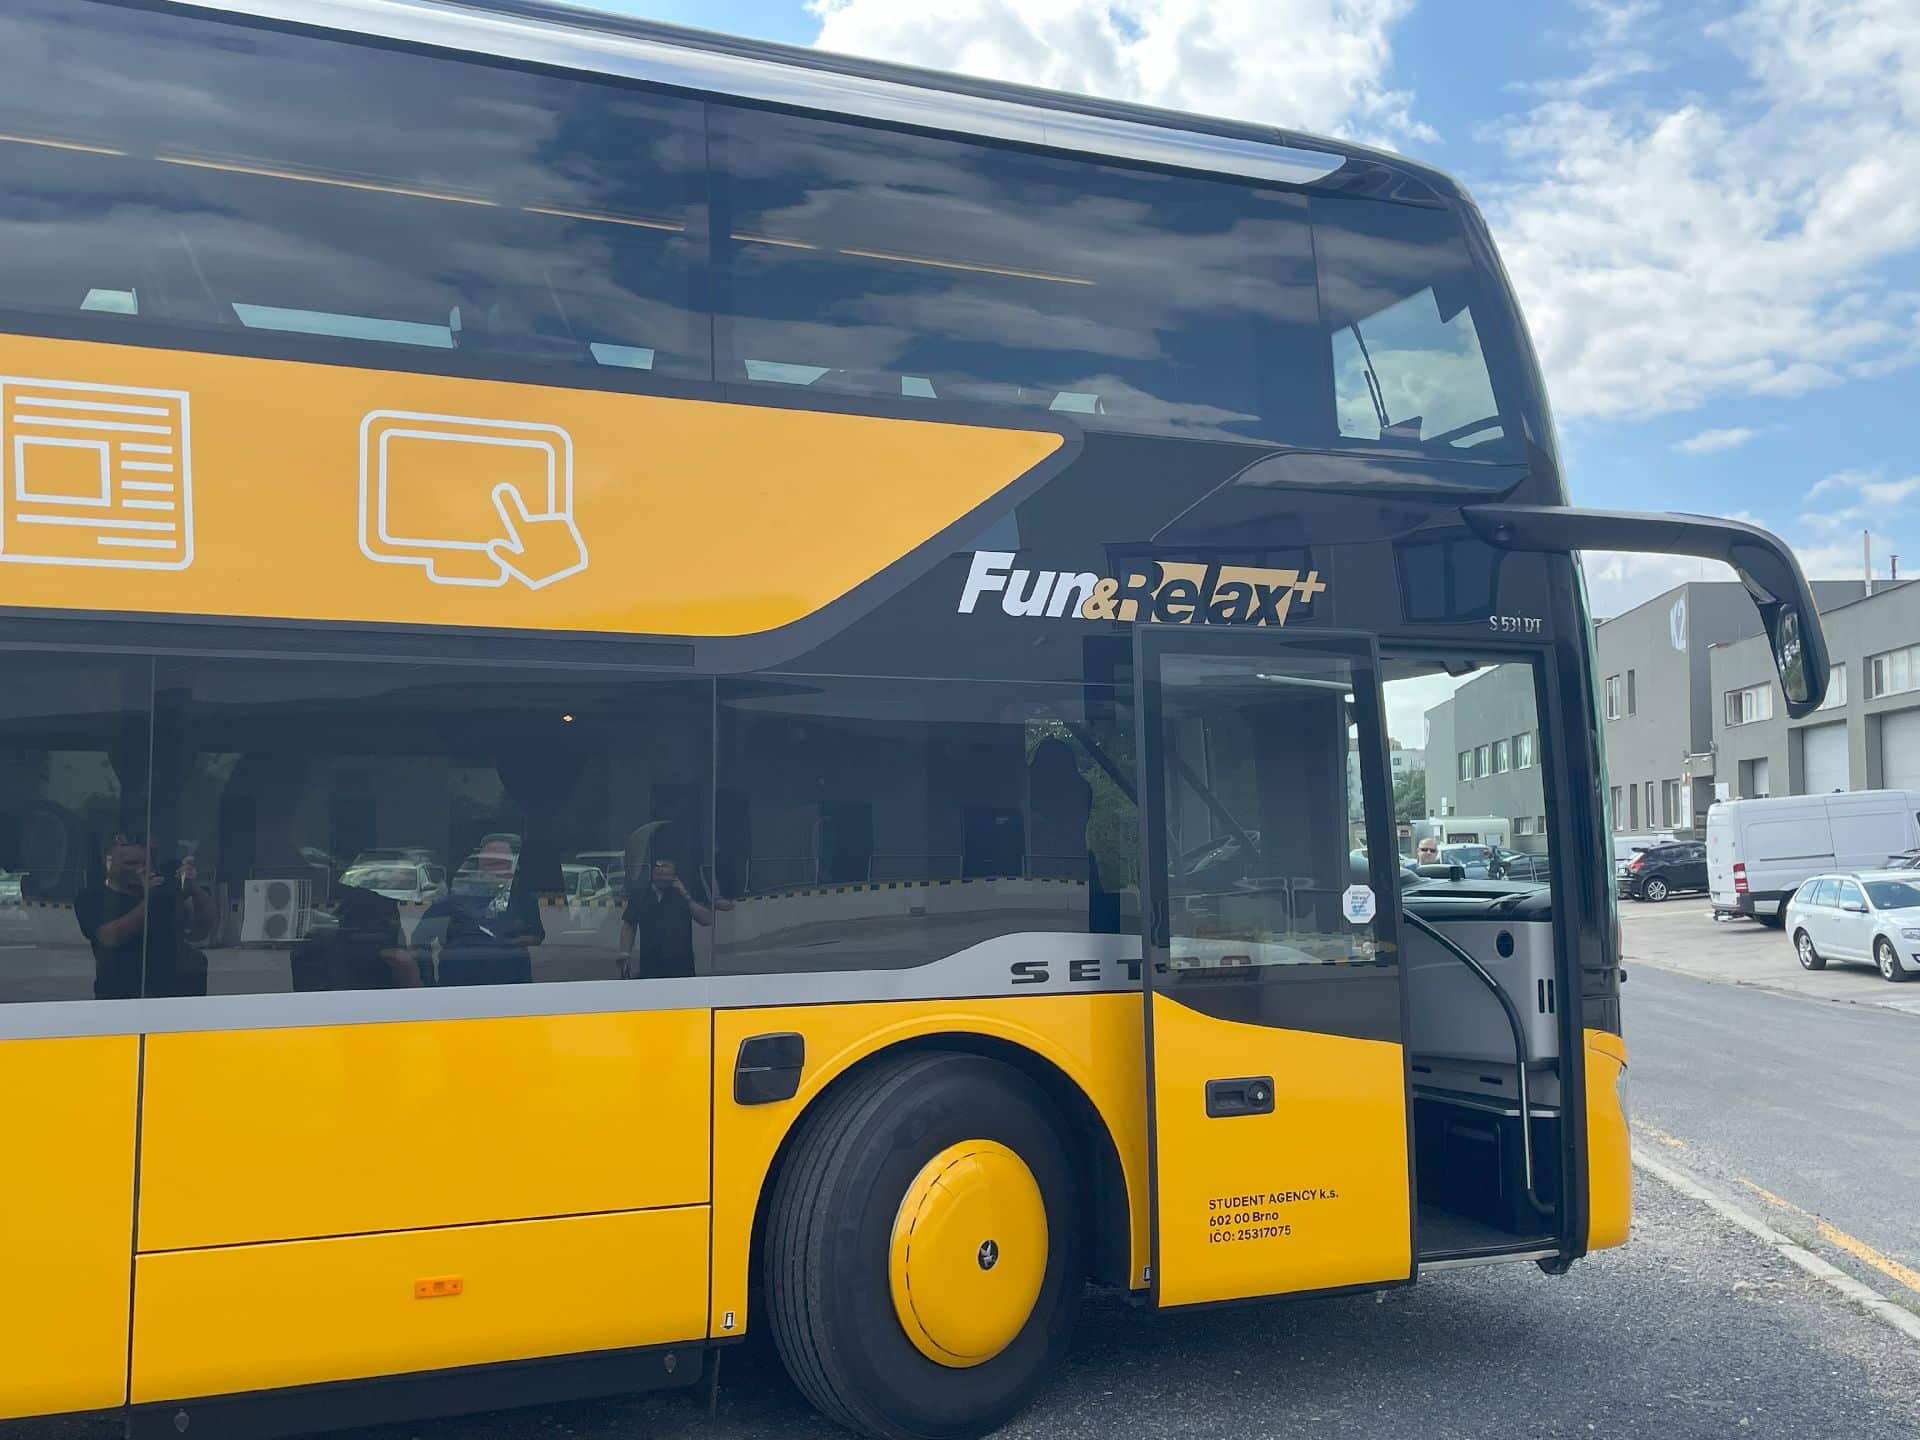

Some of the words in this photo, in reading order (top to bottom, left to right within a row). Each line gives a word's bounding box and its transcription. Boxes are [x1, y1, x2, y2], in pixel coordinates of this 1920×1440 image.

[957, 550, 1326, 627] Fun&Relax+
[1488, 615, 1498, 631] S
[1501, 616, 1521, 633] 531
[1523, 617, 1542, 634] DT
[1209, 1194, 1265, 1210] STUDENT
[1268, 1189, 1317, 1204] AGENCY
[1319, 1188, 1339, 1200] k.s.
[1209, 1214, 1231, 1227] 602
[1234, 1212, 1250, 1224] 00
[1252, 1211, 1279, 1223] Brno
[1209, 1229, 1235, 1243] IČO:
[1237, 1225, 1291, 1241] 25317075
